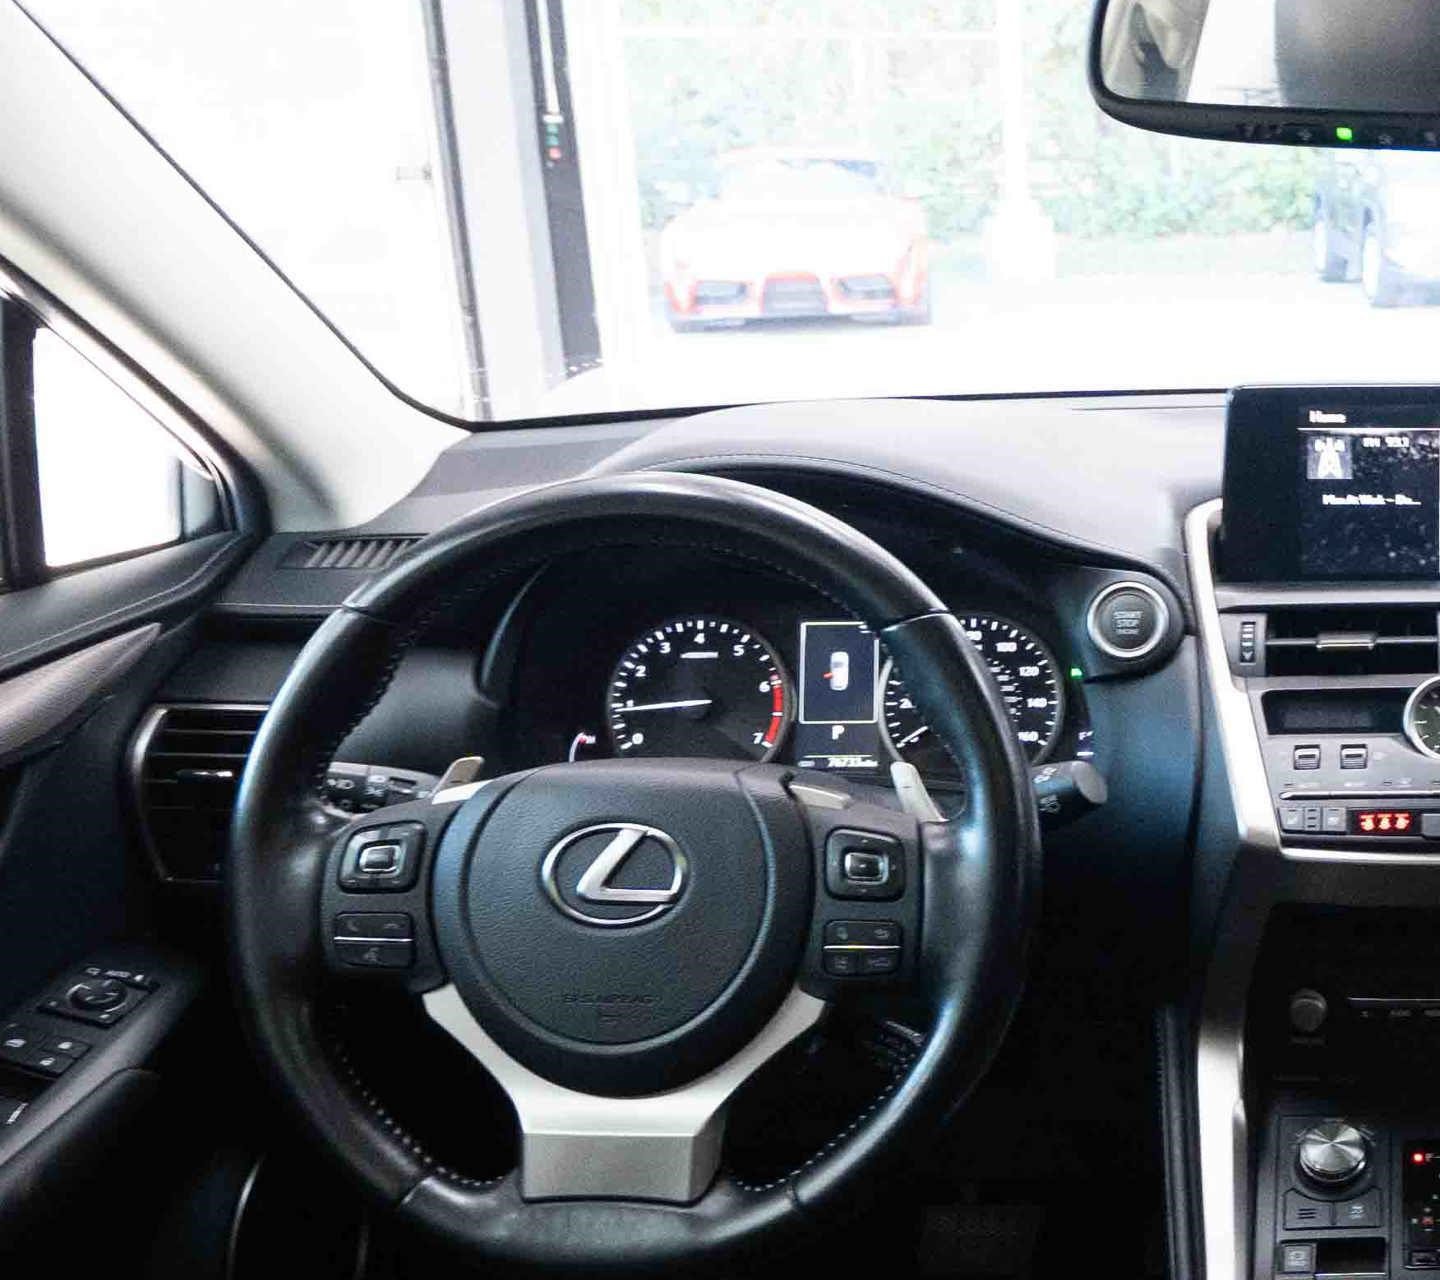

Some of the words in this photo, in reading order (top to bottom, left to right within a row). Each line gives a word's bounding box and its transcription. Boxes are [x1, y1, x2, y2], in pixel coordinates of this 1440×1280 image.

[693, 632, 705, 645] 4
[659, 642, 671, 654] 3
[733, 644, 745, 657] 5
[635, 665, 646, 677] 2
[759, 681, 770, 693] 6
[631, 732, 644, 745] 0
[752, 731, 764, 744] 7
[831, 724, 845, 740] P
